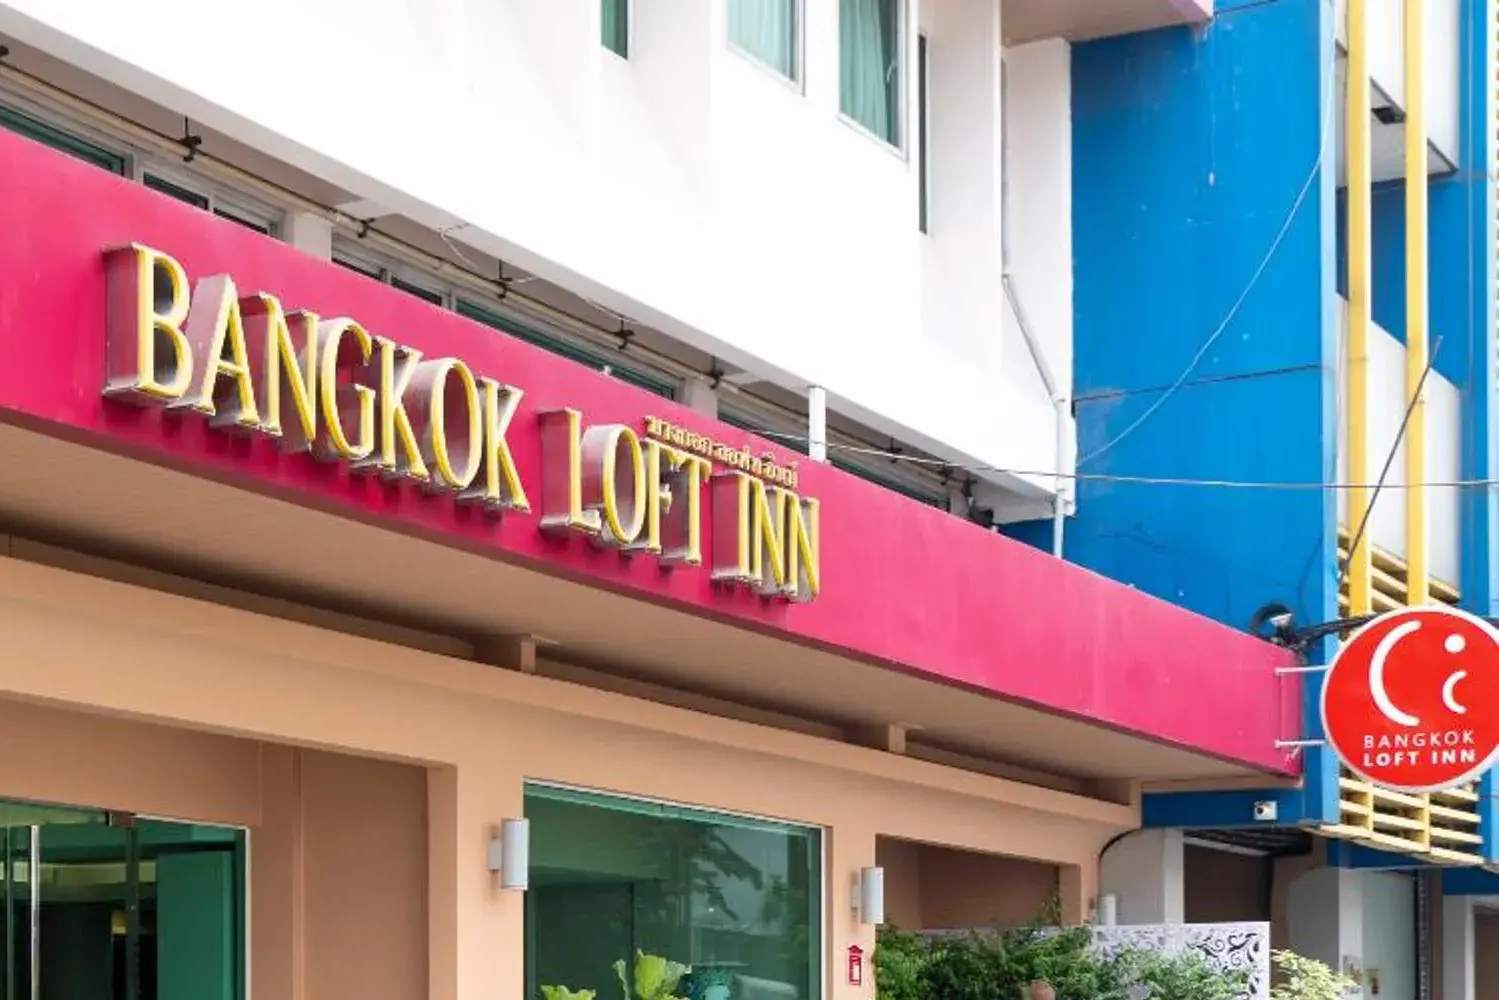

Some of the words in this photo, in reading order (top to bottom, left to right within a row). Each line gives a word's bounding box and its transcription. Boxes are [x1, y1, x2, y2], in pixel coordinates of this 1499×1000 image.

[106, 241, 531, 514] BANGKOK
[539, 405, 712, 566] LOFT
[712, 470, 820, 603] INN
[1364, 730, 1474, 748] BANGKOK
[1364, 750, 1420, 767] LOFT
[1431, 749, 1475, 764] INN
